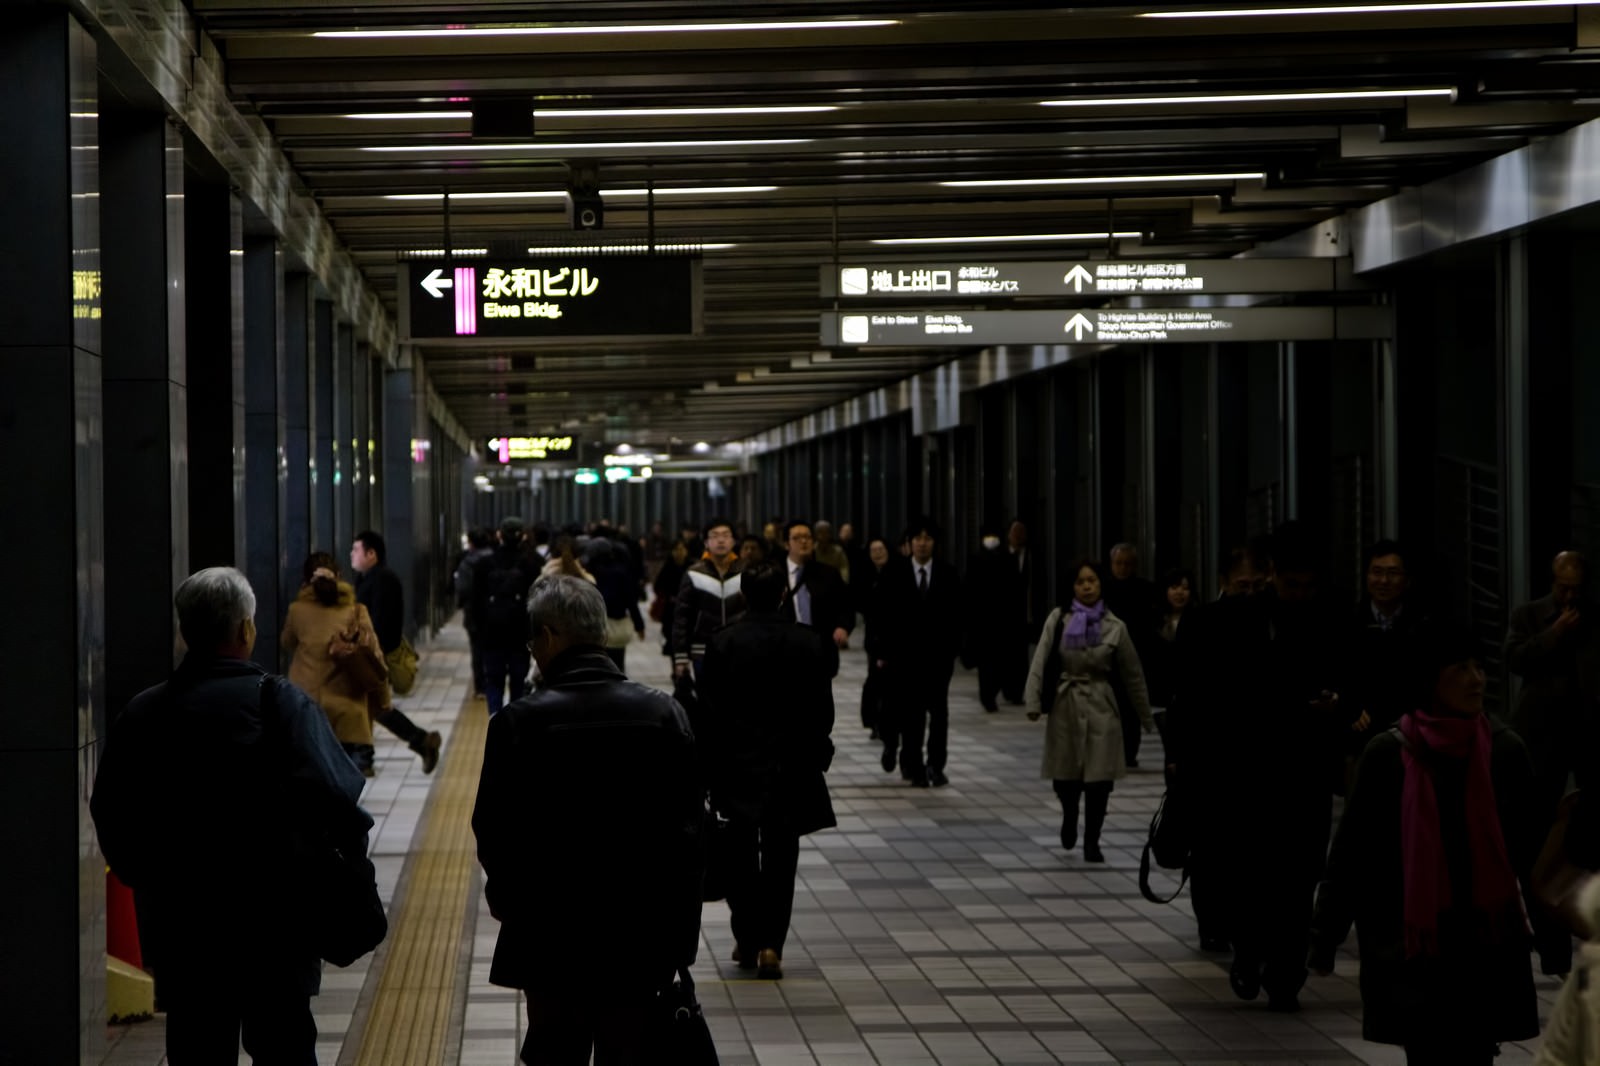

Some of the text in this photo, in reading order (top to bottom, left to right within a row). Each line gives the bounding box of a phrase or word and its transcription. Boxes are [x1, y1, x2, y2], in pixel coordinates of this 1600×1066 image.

[958, 267, 998, 278] 永和ビル
[483, 268, 599, 298] 永和ビル
[872, 270, 951, 291] 地上出口
[484, 302, 562, 319] Eiwa Bldg.
[872, 316, 918, 324] Exit to Street
[1108, 314, 1137, 322] Highrise
[1138, 313, 1166, 322] Building
[1168, 313, 1174, 321] &
[1097, 320, 1232, 331] Tokyo Metropolitan Government Office
[1151, 331, 1167, 339] Park
